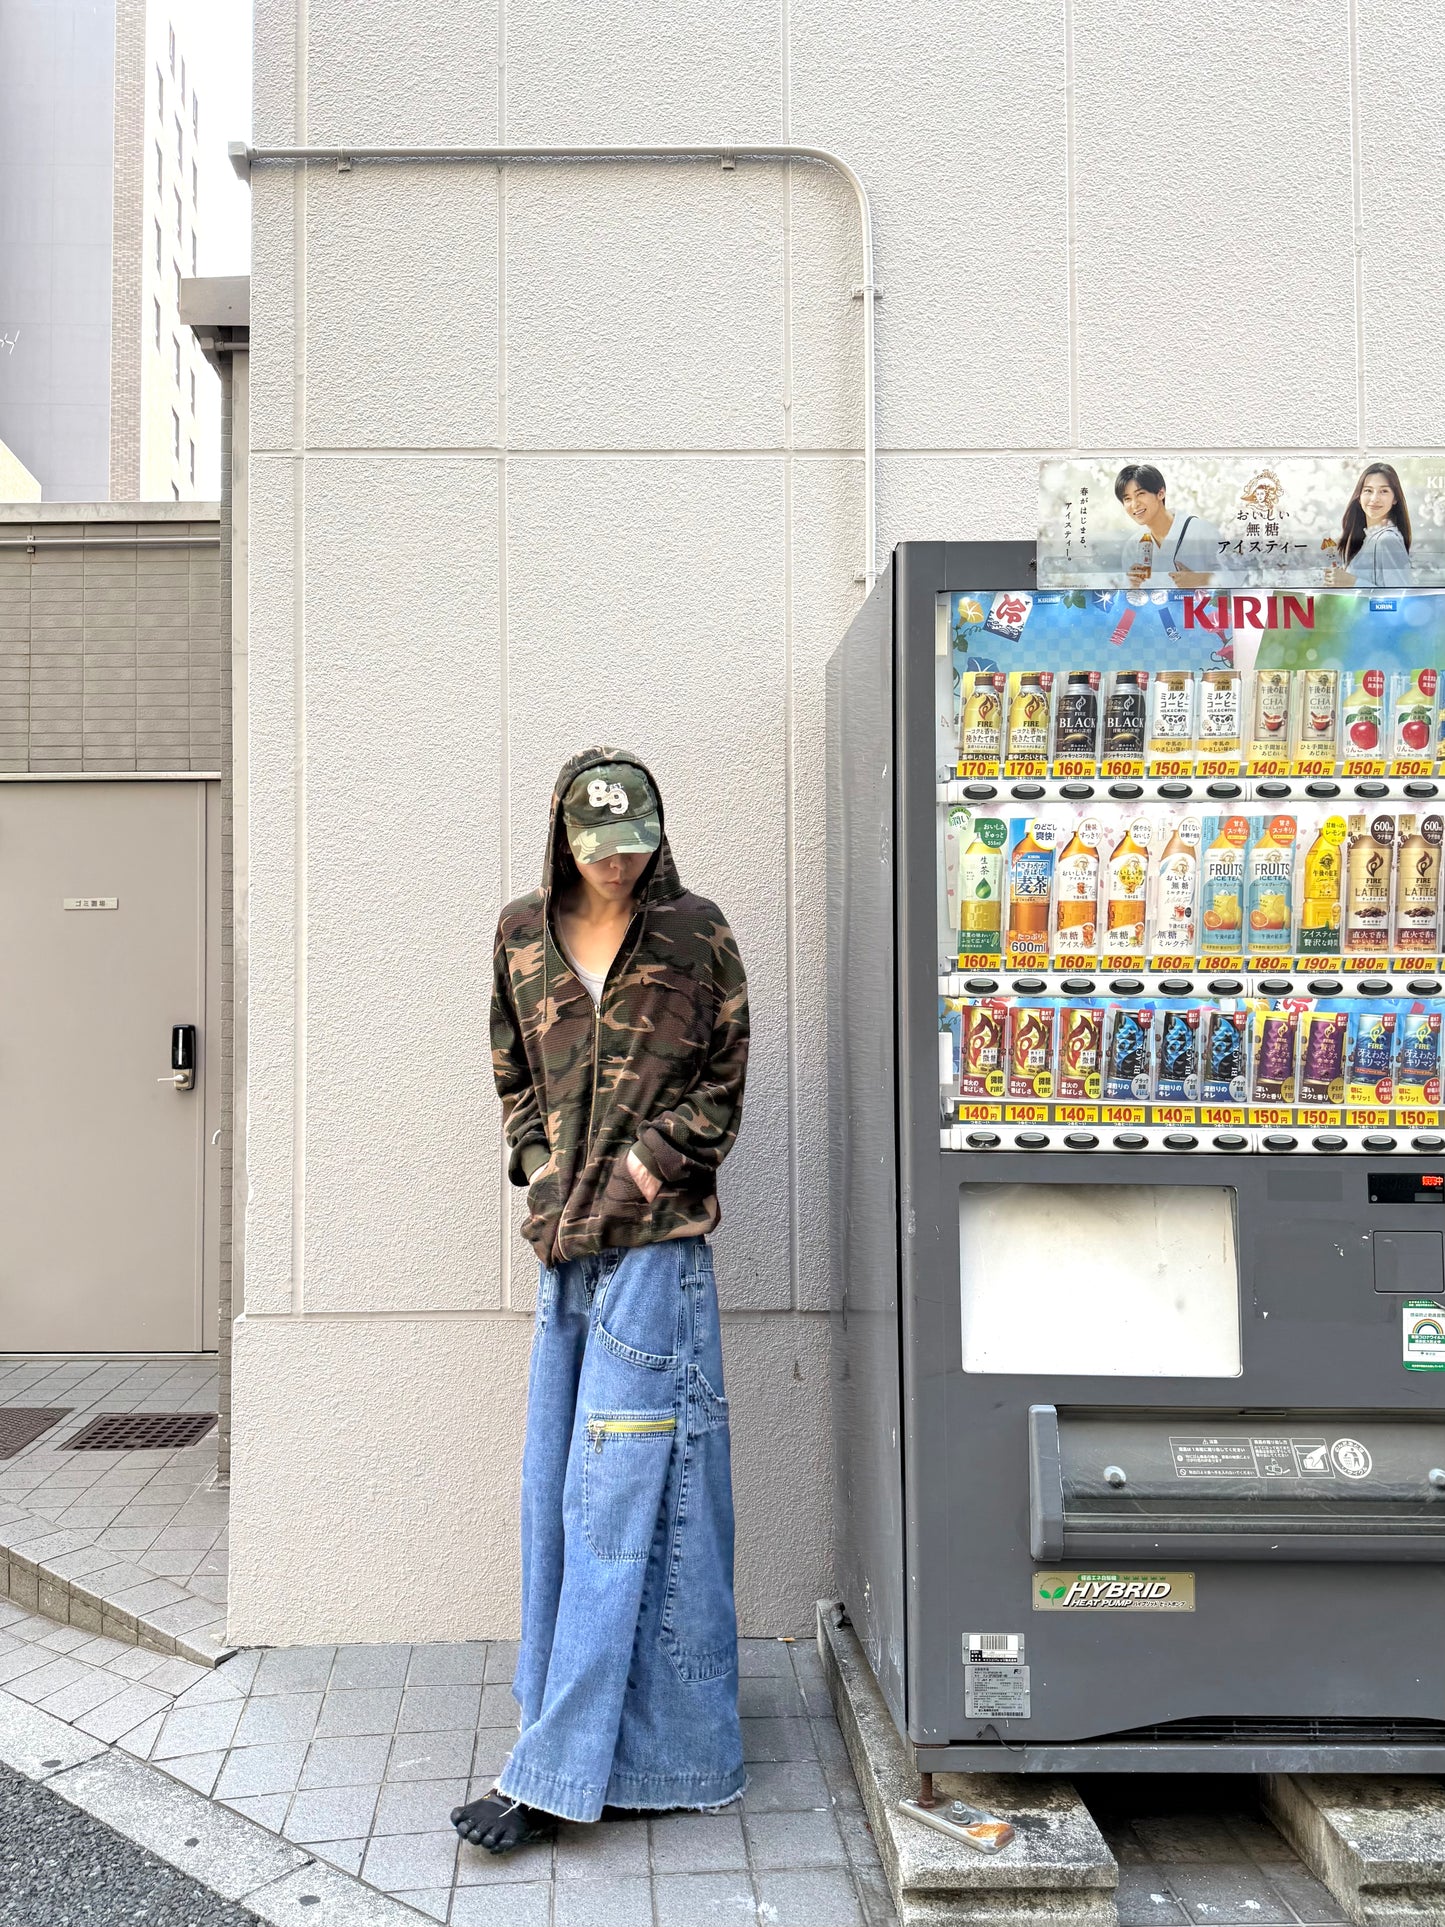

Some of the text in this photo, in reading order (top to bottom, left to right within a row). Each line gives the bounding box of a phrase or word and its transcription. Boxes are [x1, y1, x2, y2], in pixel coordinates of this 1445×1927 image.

[1080, 487, 1089, 549] 春がはじまる、
[1236, 509, 1291, 521] おいしい
[1064, 502, 1073, 561] アイスティー。
[1246, 522, 1280, 537] 無糖
[1217, 539, 1308, 554] アイスティー
[1183, 595, 1315, 629] KIRIN
[962, 762, 995, 776] 170円
[1010, 762, 1043, 776] 170円
[1058, 762, 1092, 776] 160円
[1107, 762, 1140, 776] 160円
[1155, 762, 1188, 775] 150円
[1202, 762, 1235, 775] 150円
[1253, 761, 1285, 775] 140円
[1297, 761, 1330, 775] 140円
[1348, 761, 1381, 775] 150円
[1396, 761, 1428, 775] 150円
[1034, 823, 1057, 831] のどごし
[980, 856, 989, 875] 生茶
[1209, 863, 1243, 876] FRUITS
[1255, 863, 1290, 876] FRUITS
[1017, 876, 1047, 894] 麦茶
[1171, 882, 1189, 890] 無糖
[1355, 887, 1386, 897] LATTE
[1405, 887, 1435, 897] LATTE
[1017, 933, 1044, 941] たっぷり
[1059, 931, 1079, 940] 無糖
[1109, 931, 1129, 940] 無糖
[1157, 930, 1177, 939] 無糖
[1011, 941, 1046, 953] 600ml
[963, 954, 997, 968] 160円
[1011, 955, 1045, 968] 140円
[1060, 956, 1093, 969] 160円
[1107, 956, 1140, 969] 160円
[1157, 957, 1190, 969] 160円
[1205, 957, 1237, 969] 180円
[1254, 957, 1287, 969] 180円
[1304, 957, 1336, 969] 190円
[1351, 957, 1384, 969] 180円
[1400, 957, 1433, 969] 180円
[964, 1106, 997, 1120] 140円
[1010, 1106, 1044, 1120] 140円
[1060, 1107, 1094, 1121] 140円
[1107, 1108, 1141, 1122] 140円
[1157, 1108, 1191, 1122] 140円
[1206, 1109, 1241, 1123] 140円
[1254, 1110, 1288, 1124] 150円
[1303, 1110, 1336, 1124] 150円
[1351, 1111, 1385, 1125] 150円
[1401, 1111, 1435, 1125] 150円
[1063, 1581, 1172, 1607] HYBRID
[1072, 1600, 1101, 1608] HEAT
